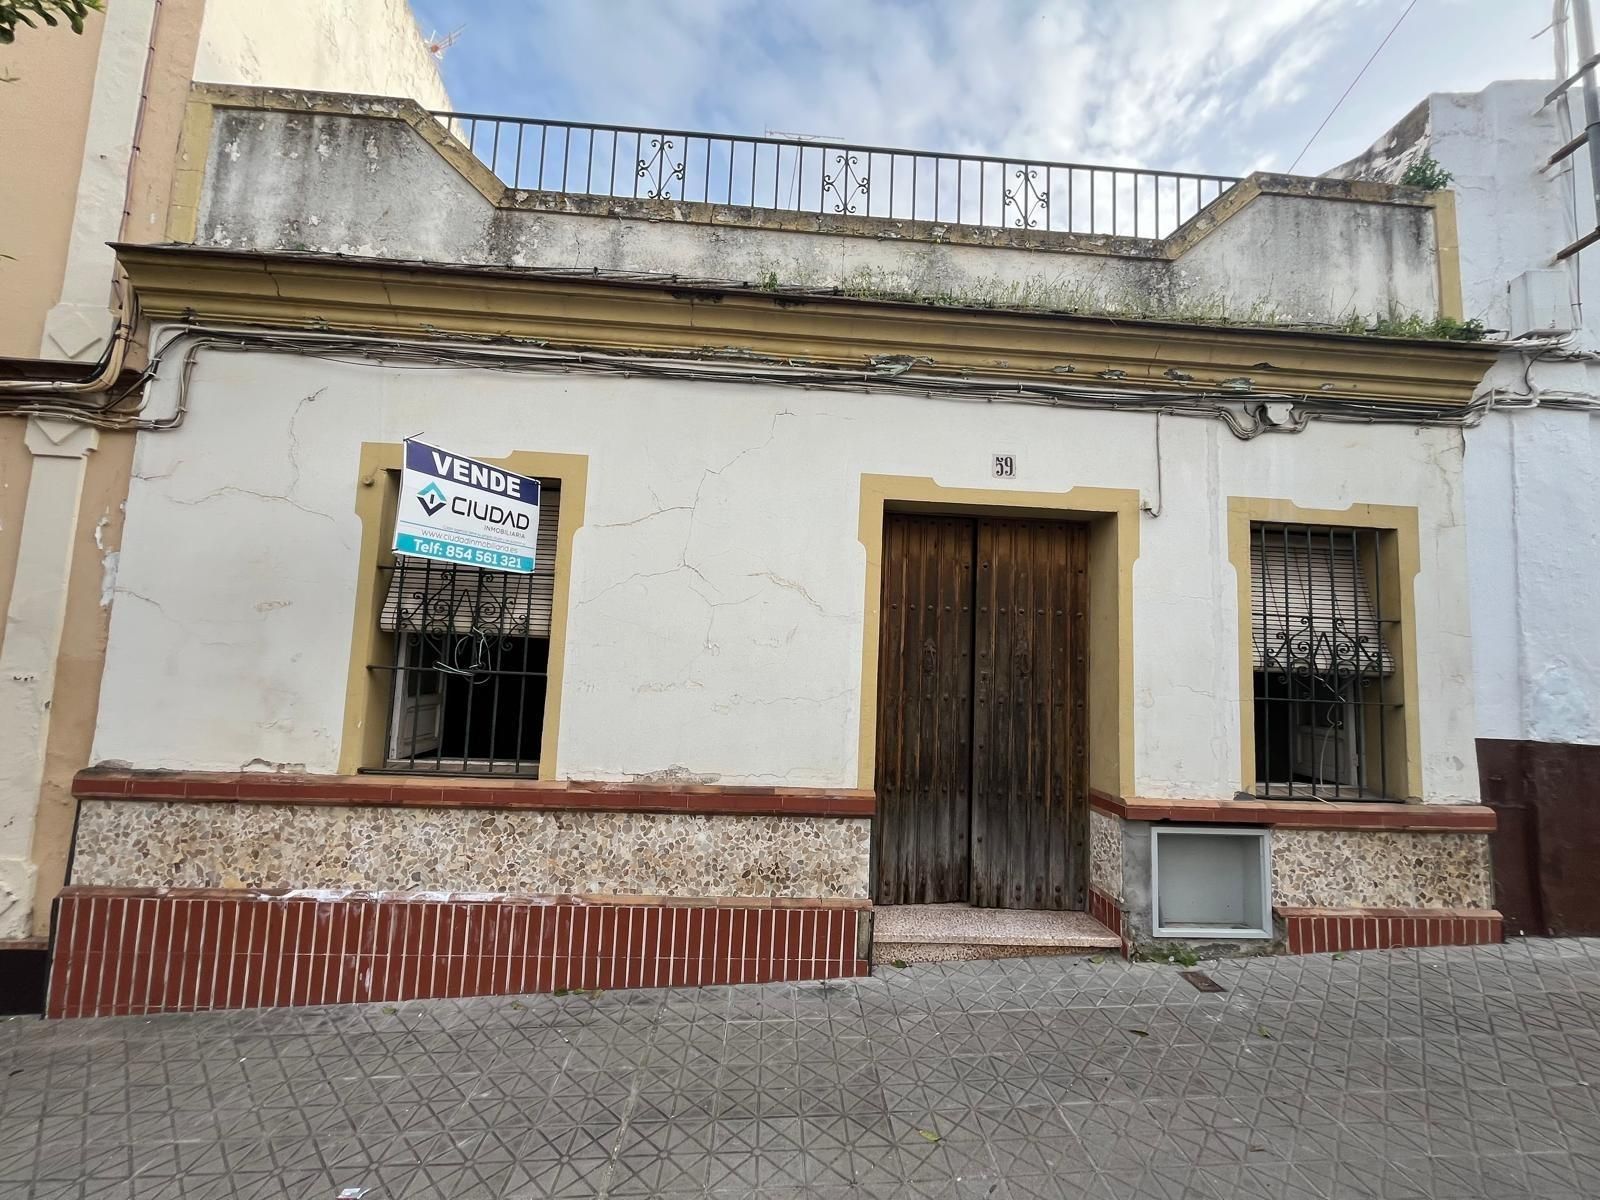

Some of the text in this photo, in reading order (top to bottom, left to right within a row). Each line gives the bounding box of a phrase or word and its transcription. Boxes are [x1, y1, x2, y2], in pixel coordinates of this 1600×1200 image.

[431, 451, 521, 498] VENDE
[451, 496, 530, 530] CIUDAD
[484, 525, 525, 539] INMOBILIARIA
[413, 539, 522, 569] Telf: 854 561 321
